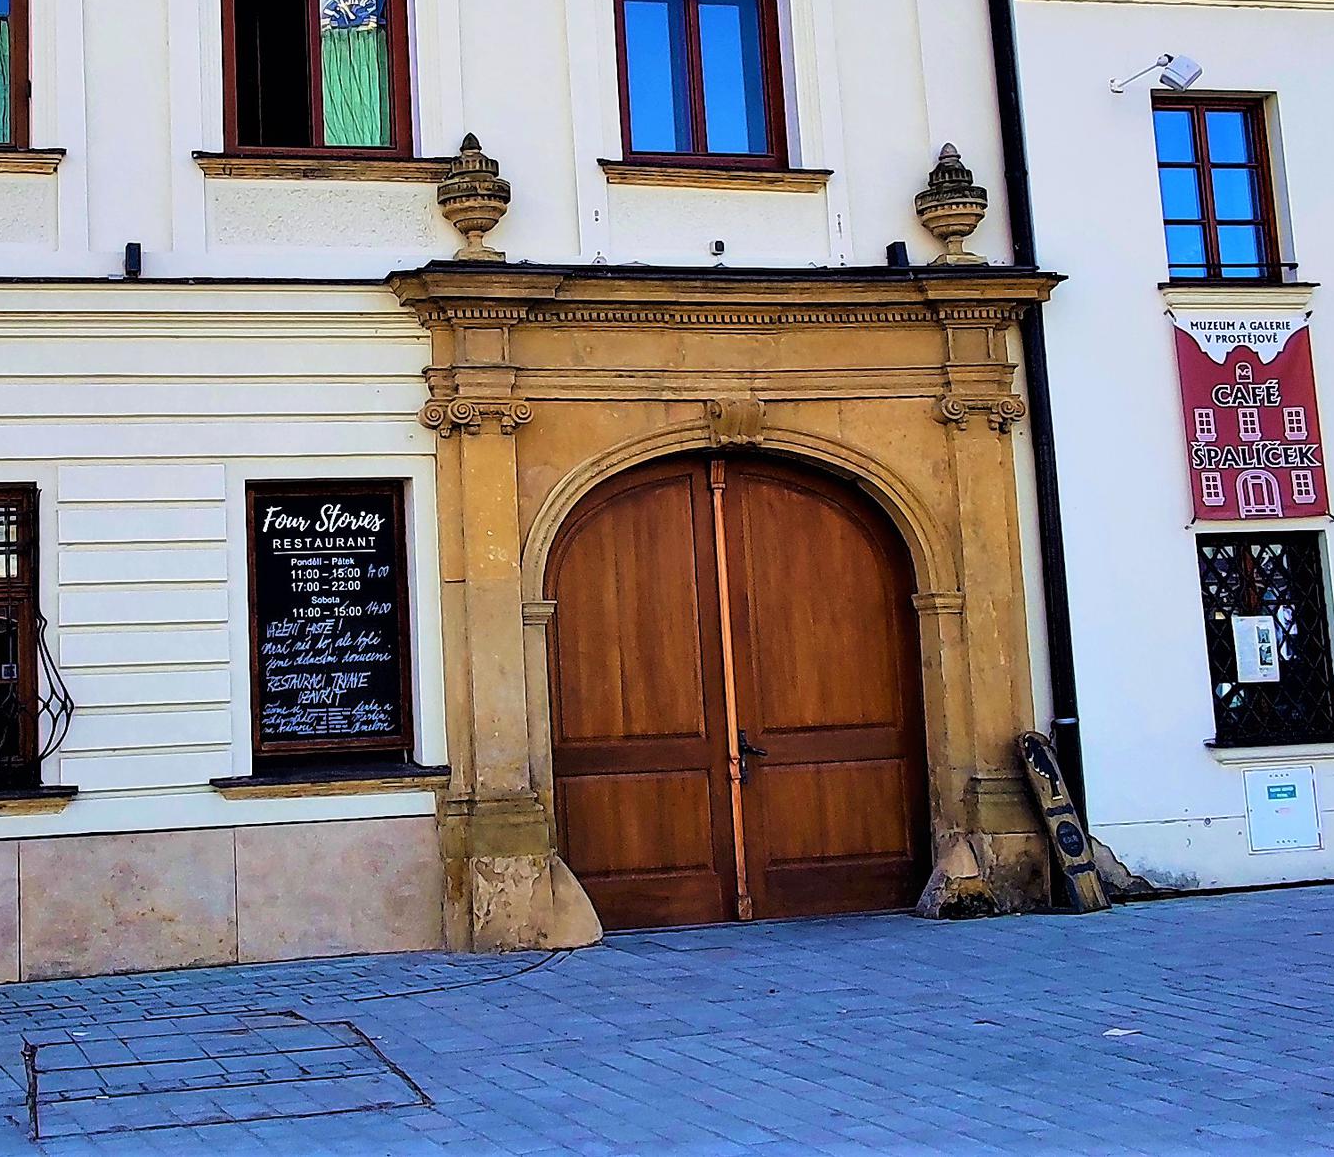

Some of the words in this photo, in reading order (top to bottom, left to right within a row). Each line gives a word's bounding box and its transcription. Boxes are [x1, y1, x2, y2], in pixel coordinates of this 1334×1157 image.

[1190, 320, 1236, 331] MUZEUM
[1238, 321, 1247, 330] A
[1249, 320, 1291, 331] GALERIE
[1205, 334, 1213, 344] V
[1216, 332, 1279, 345] PROSTĚJOVĚ
[1212, 379, 1281, 407] CAFÉ
[1191, 441, 1321, 469] ŠPALÍČEK
[263, 506, 311, 533] Four
[315, 504, 386, 533] Stories
[272, 537, 376, 549] RESTAURANT
[331, 557, 355, 565] Pátek
[291, 569, 319, 579] 11:00
[291, 582, 320, 592] 17:00
[331, 581, 361, 590] 22:00
[311, 596, 340, 604] Sobota
[292, 607, 321, 617] 11:00
[333, 606, 362, 616] 15:00
